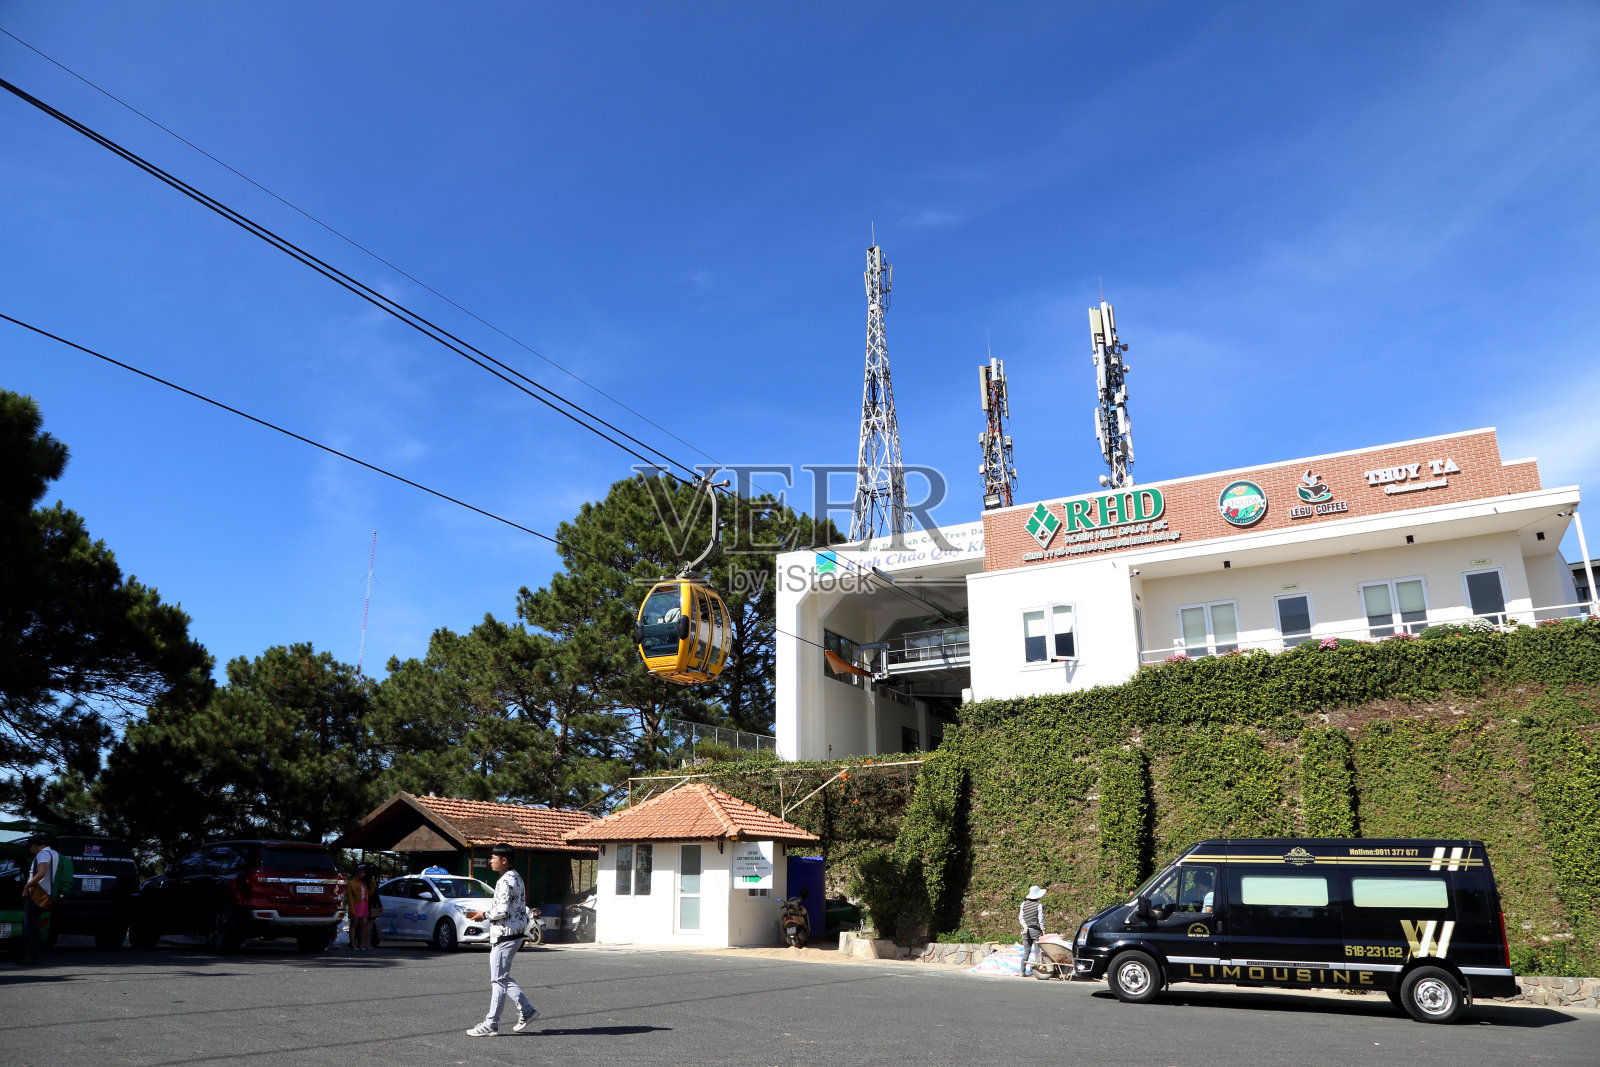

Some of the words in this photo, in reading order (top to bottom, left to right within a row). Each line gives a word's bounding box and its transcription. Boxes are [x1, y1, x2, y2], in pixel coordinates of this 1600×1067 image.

[1364, 463, 1420, 485] THUY
[1428, 457, 1460, 476] TA
[1063, 488, 1165, 534] RHD
[1316, 501, 1347, 514] COFFEE
[1065, 531, 1094, 544] ROBIN
[1096, 528, 1117, 539] HILL
[1119, 523, 1150, 535] DALAT
[1151, 520, 1168, 531] JSC
[1130, 535, 1153, 546] ROBIN
[1345, 945, 1403, 958] 51B-231.82
[1190, 964, 1374, 985] LIMOUSINE
